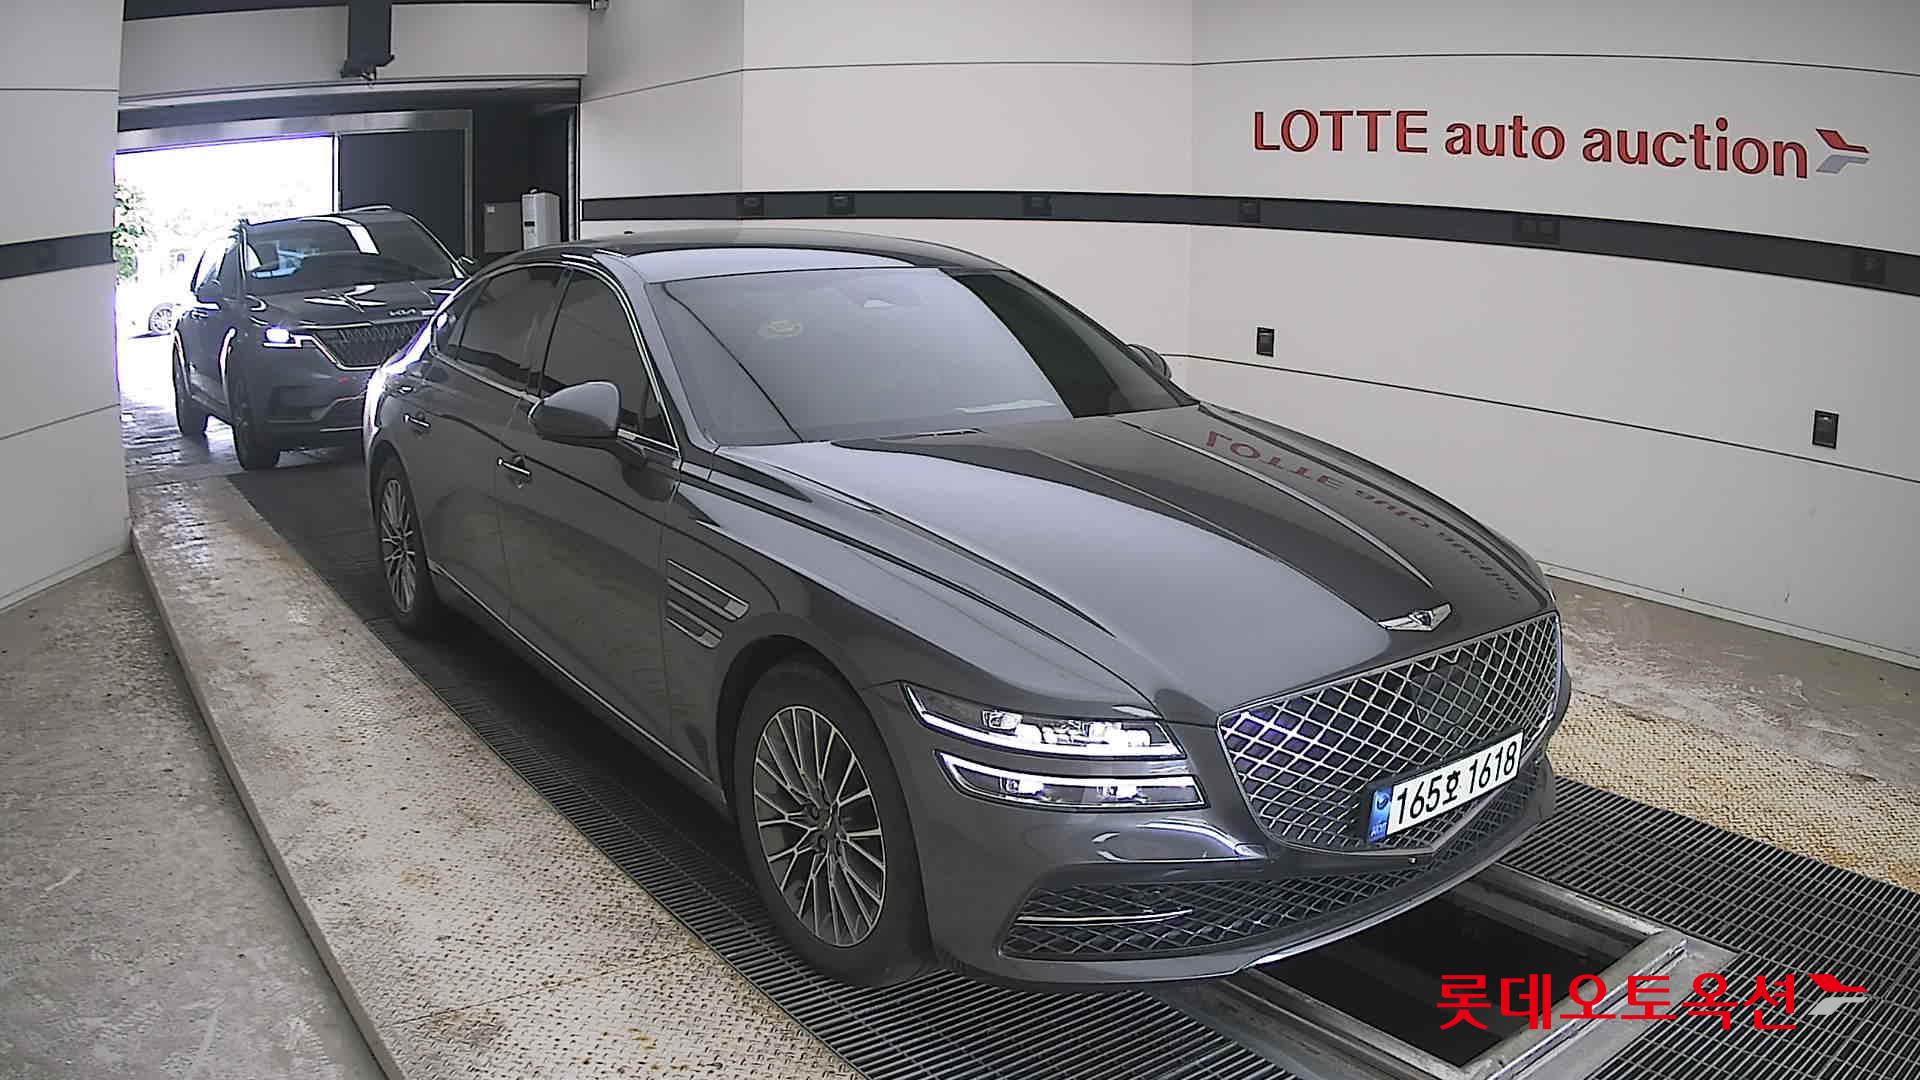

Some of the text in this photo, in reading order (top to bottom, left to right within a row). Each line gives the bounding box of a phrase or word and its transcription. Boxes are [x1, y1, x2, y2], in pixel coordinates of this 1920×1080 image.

[1253, 110, 1808, 179] LOTTE auto auction
[1397, 740, 1518, 825] 165호 1618
